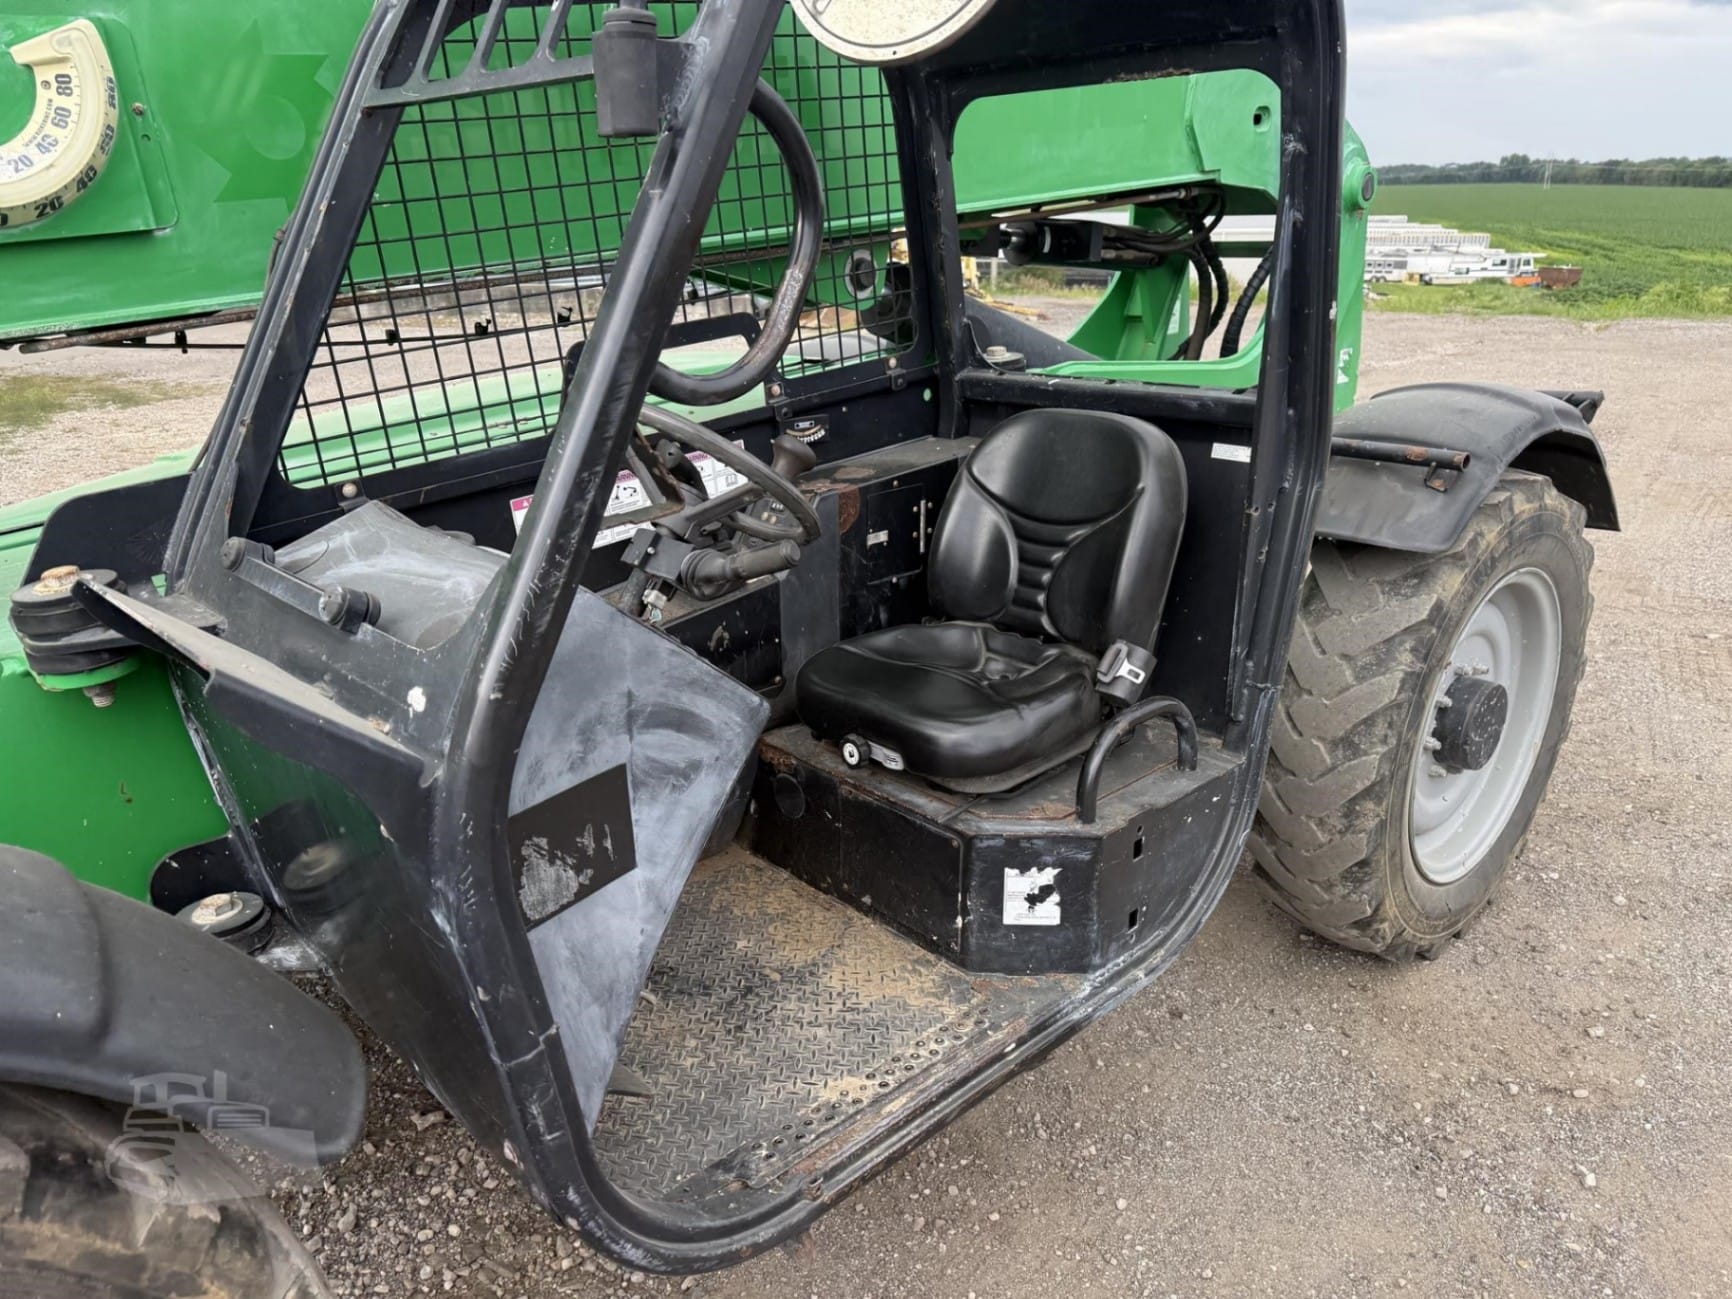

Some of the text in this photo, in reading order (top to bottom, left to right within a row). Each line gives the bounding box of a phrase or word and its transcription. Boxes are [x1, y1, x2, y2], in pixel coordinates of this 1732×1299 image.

[55, 73, 73, 97] 80
[52, 107, 72, 129] 60
[35, 134, 59, 155] 40
[7, 154, 34, 174] 20
[34, 196, 64, 218] 20
